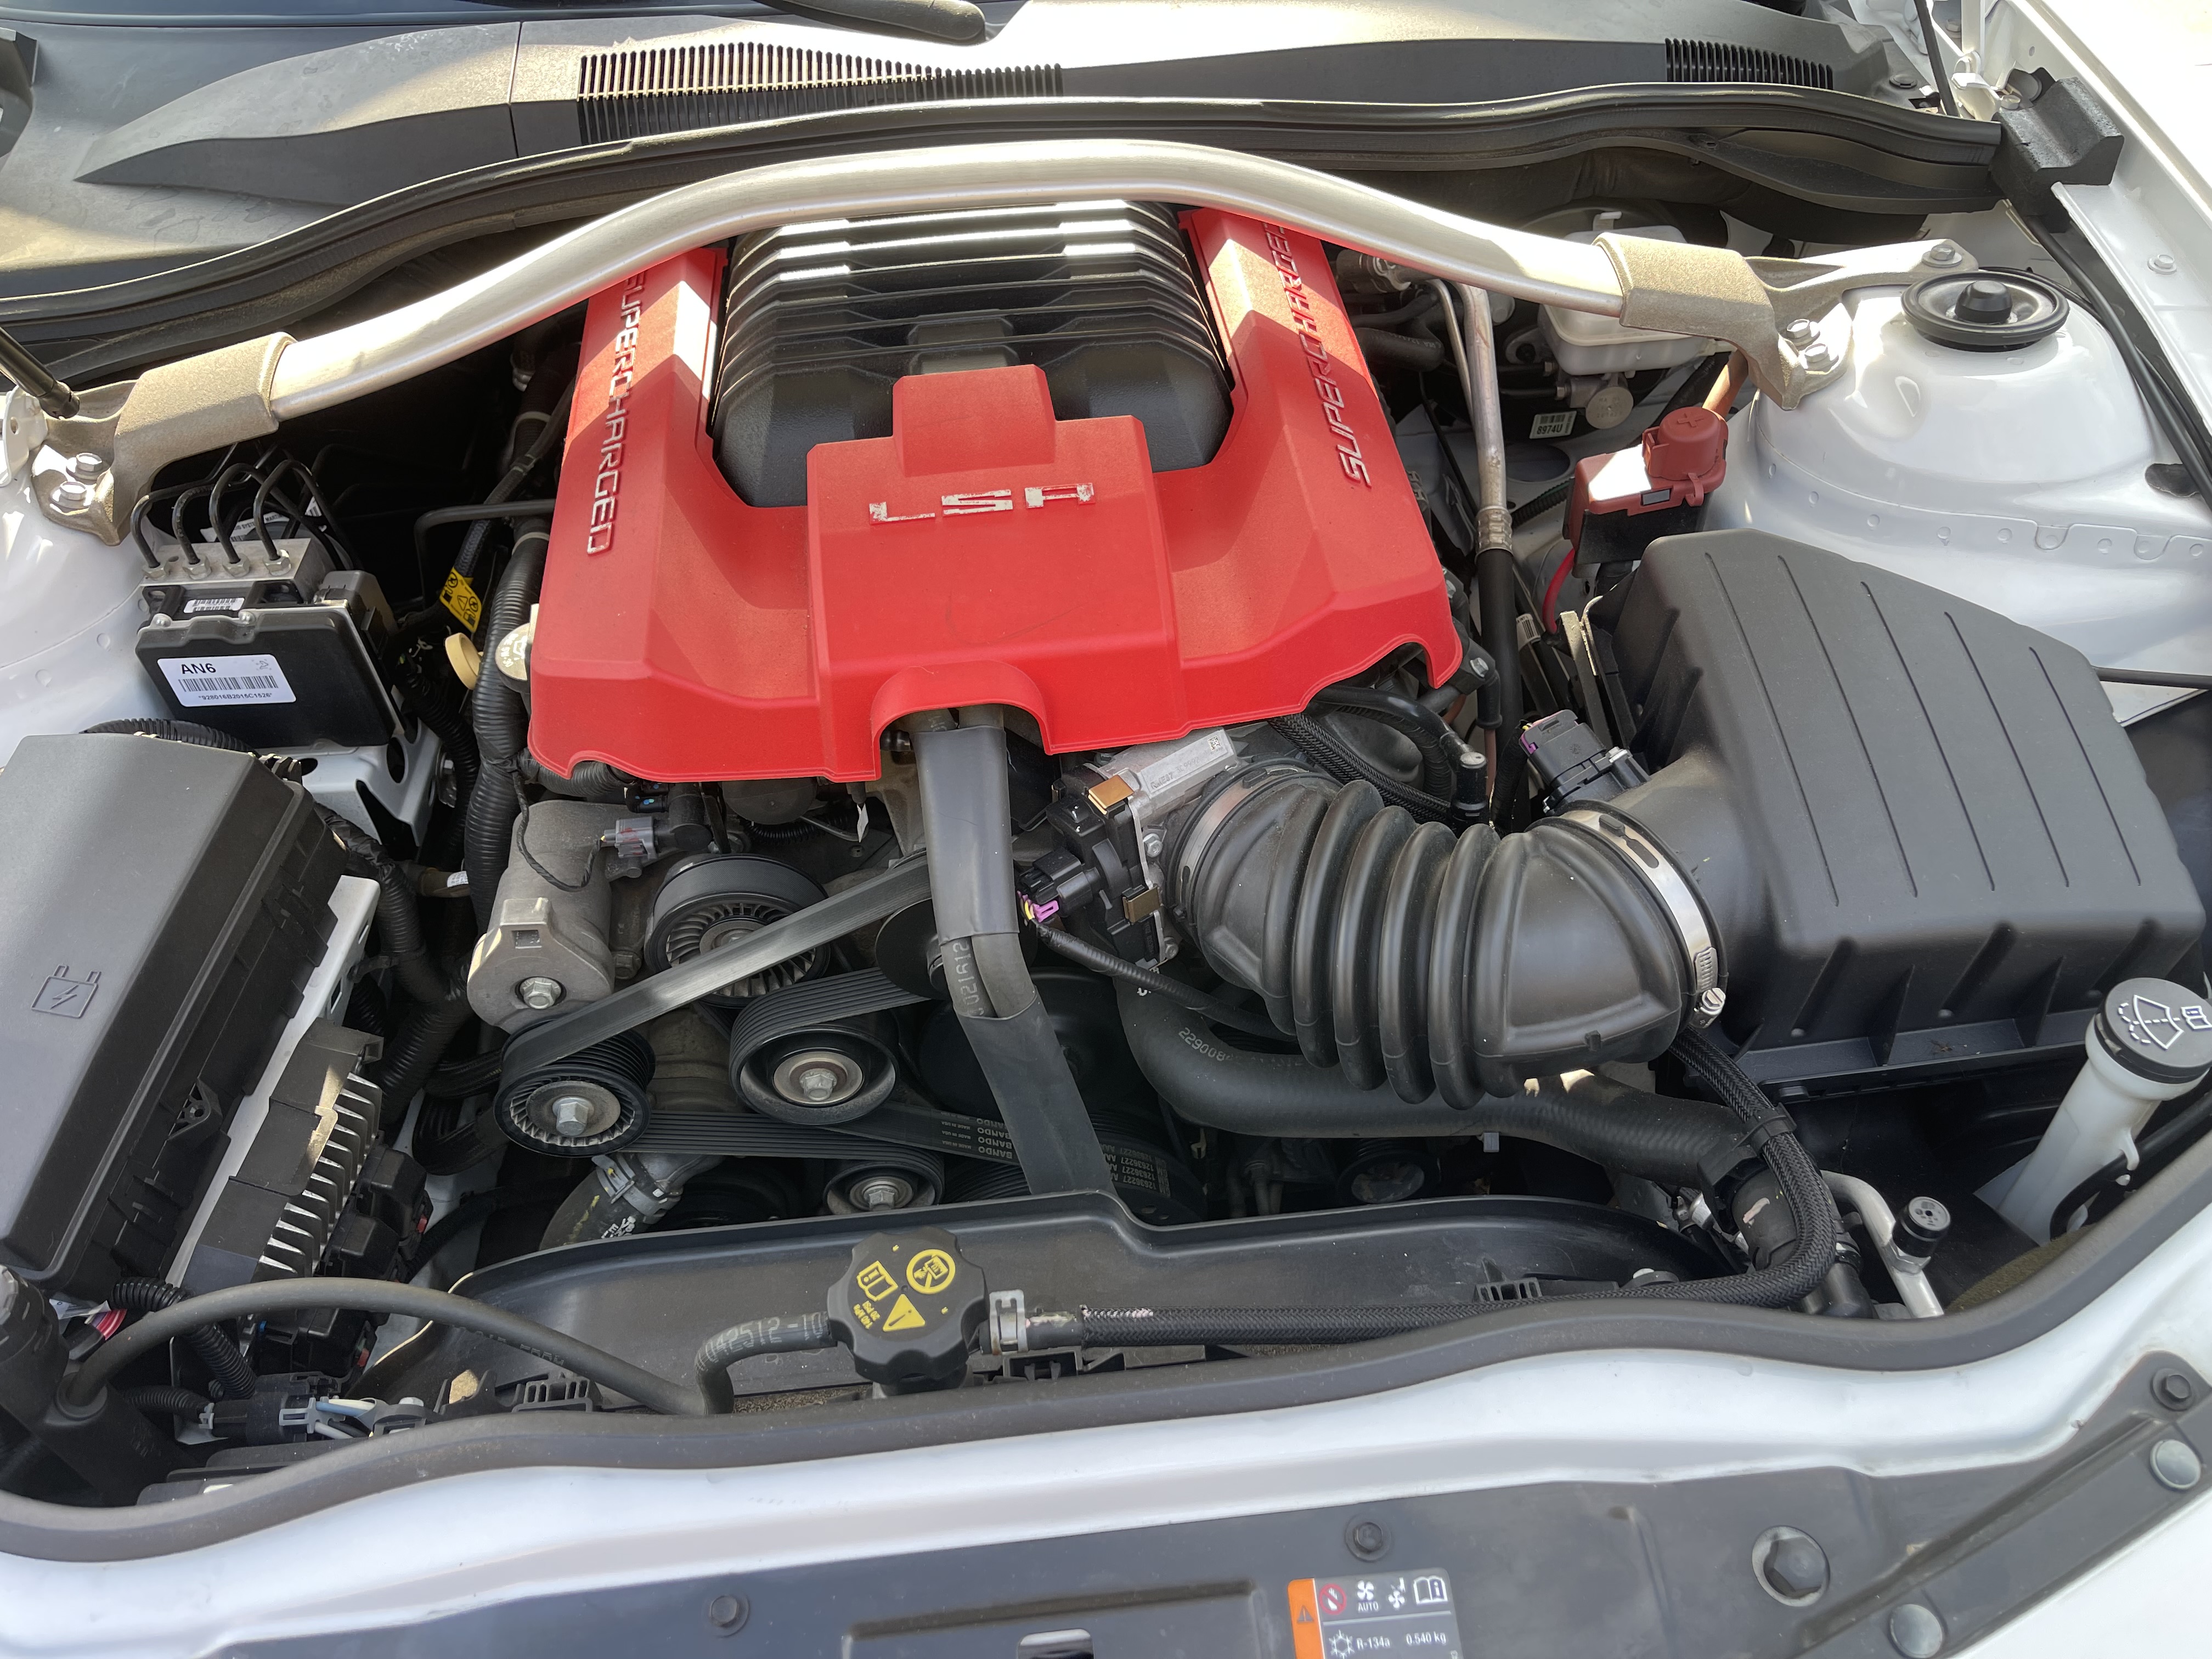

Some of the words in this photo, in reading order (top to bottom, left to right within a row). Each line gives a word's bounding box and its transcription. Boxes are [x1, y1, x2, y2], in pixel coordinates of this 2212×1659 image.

[1537, 425, 1562, 435] 8974U
[869, 483, 1096, 524] LSA
[182, 663, 216, 674] AN6
[978, 1136, 1012, 1149] BANDO
[978, 1146, 1013, 1159] BANDO
[1358, 1601, 1379, 1612] AUTO
[1357, 1636, 1390, 1650] R-134a
[1406, 1632, 1432, 1645] 0.540
[1434, 1631, 1446, 1645] kg
